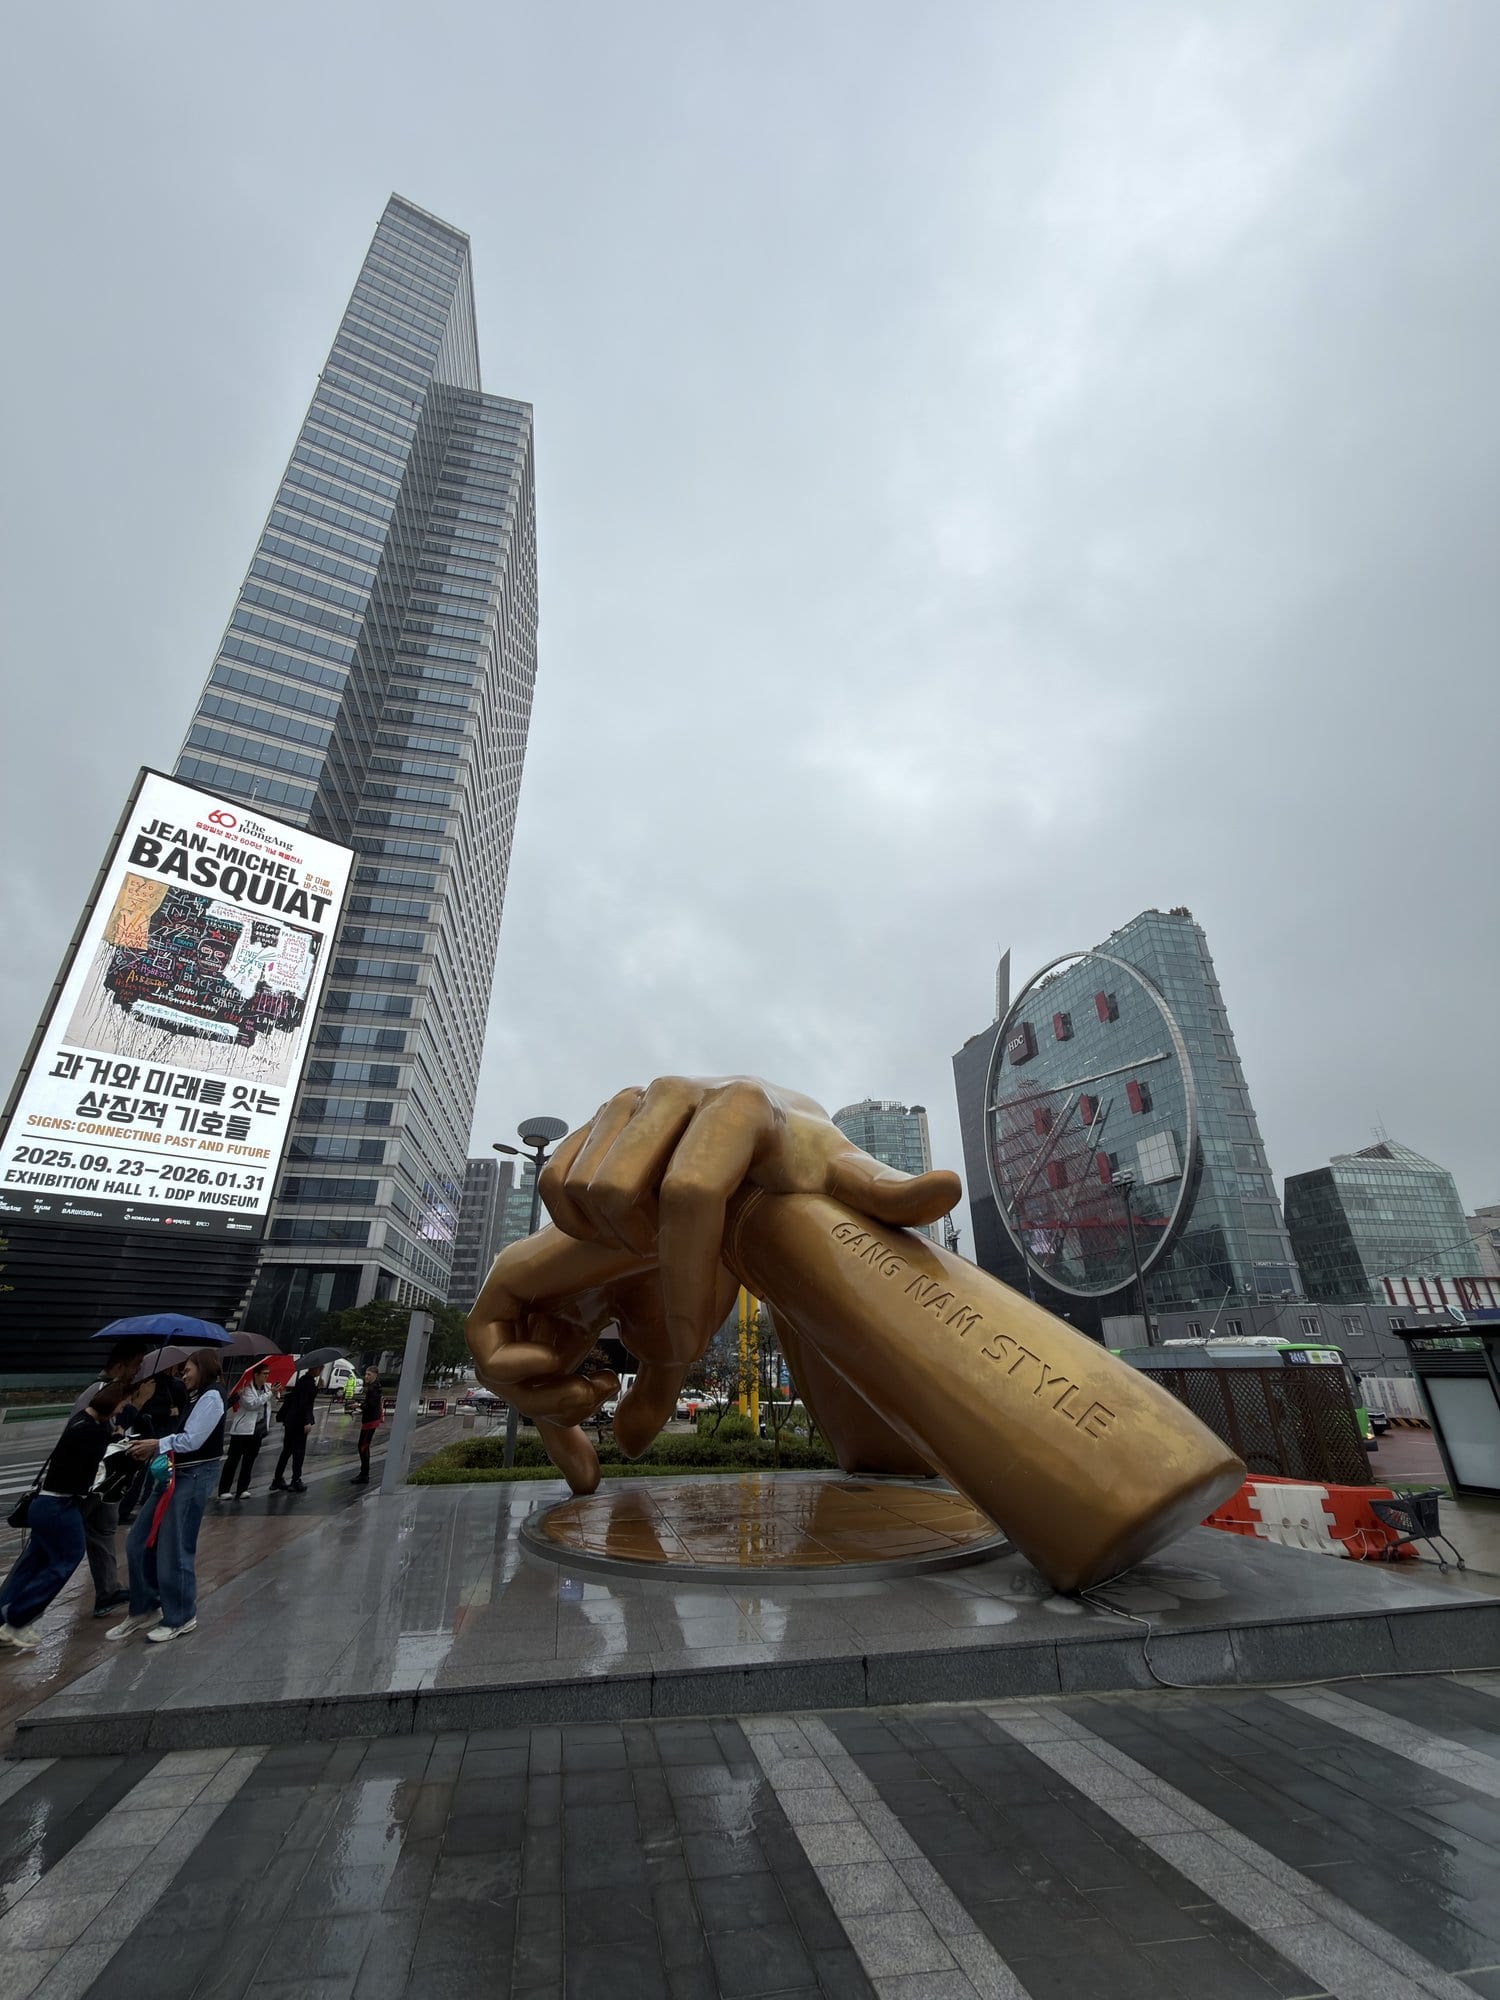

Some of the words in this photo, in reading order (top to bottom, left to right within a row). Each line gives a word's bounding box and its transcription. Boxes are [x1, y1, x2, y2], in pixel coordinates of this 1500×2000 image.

[208, 809, 237, 828] 60
[244, 819, 266, 833] The
[140, 819, 299, 885] JEAN-MICHEL
[239, 837, 263, 850] 60주년
[128, 834, 332, 923] BASQUIAT
[303, 881, 333, 897] 바스키아
[1008, 1034, 1024, 1051] HDC
[48, 1051, 141, 1090] 과거와
[143, 1069, 227, 1106] 미래를
[229, 1085, 281, 1116] 잇는
[26, 1115, 76, 1131] SIGNS:
[77, 1121, 161, 1144] CONNECTING
[164, 1135, 197, 1150] PAST
[198, 1139, 224, 1153] AND
[226, 1143, 271, 1159] FUTURE
[76, 1091, 169, 1129] 상징적
[174, 1105, 252, 1141] 기호들
[4, 1169, 100, 1192] EXHIBITION
[103, 1180, 144, 1197] HALL
[164, 1187, 196, 1201] DDP
[199, 1191, 260, 1209] MUSEUM
[831, 1222, 908, 1277] GANG
[904, 1274, 983, 1337] NAM
[981, 1334, 1116, 1438] STYLE
